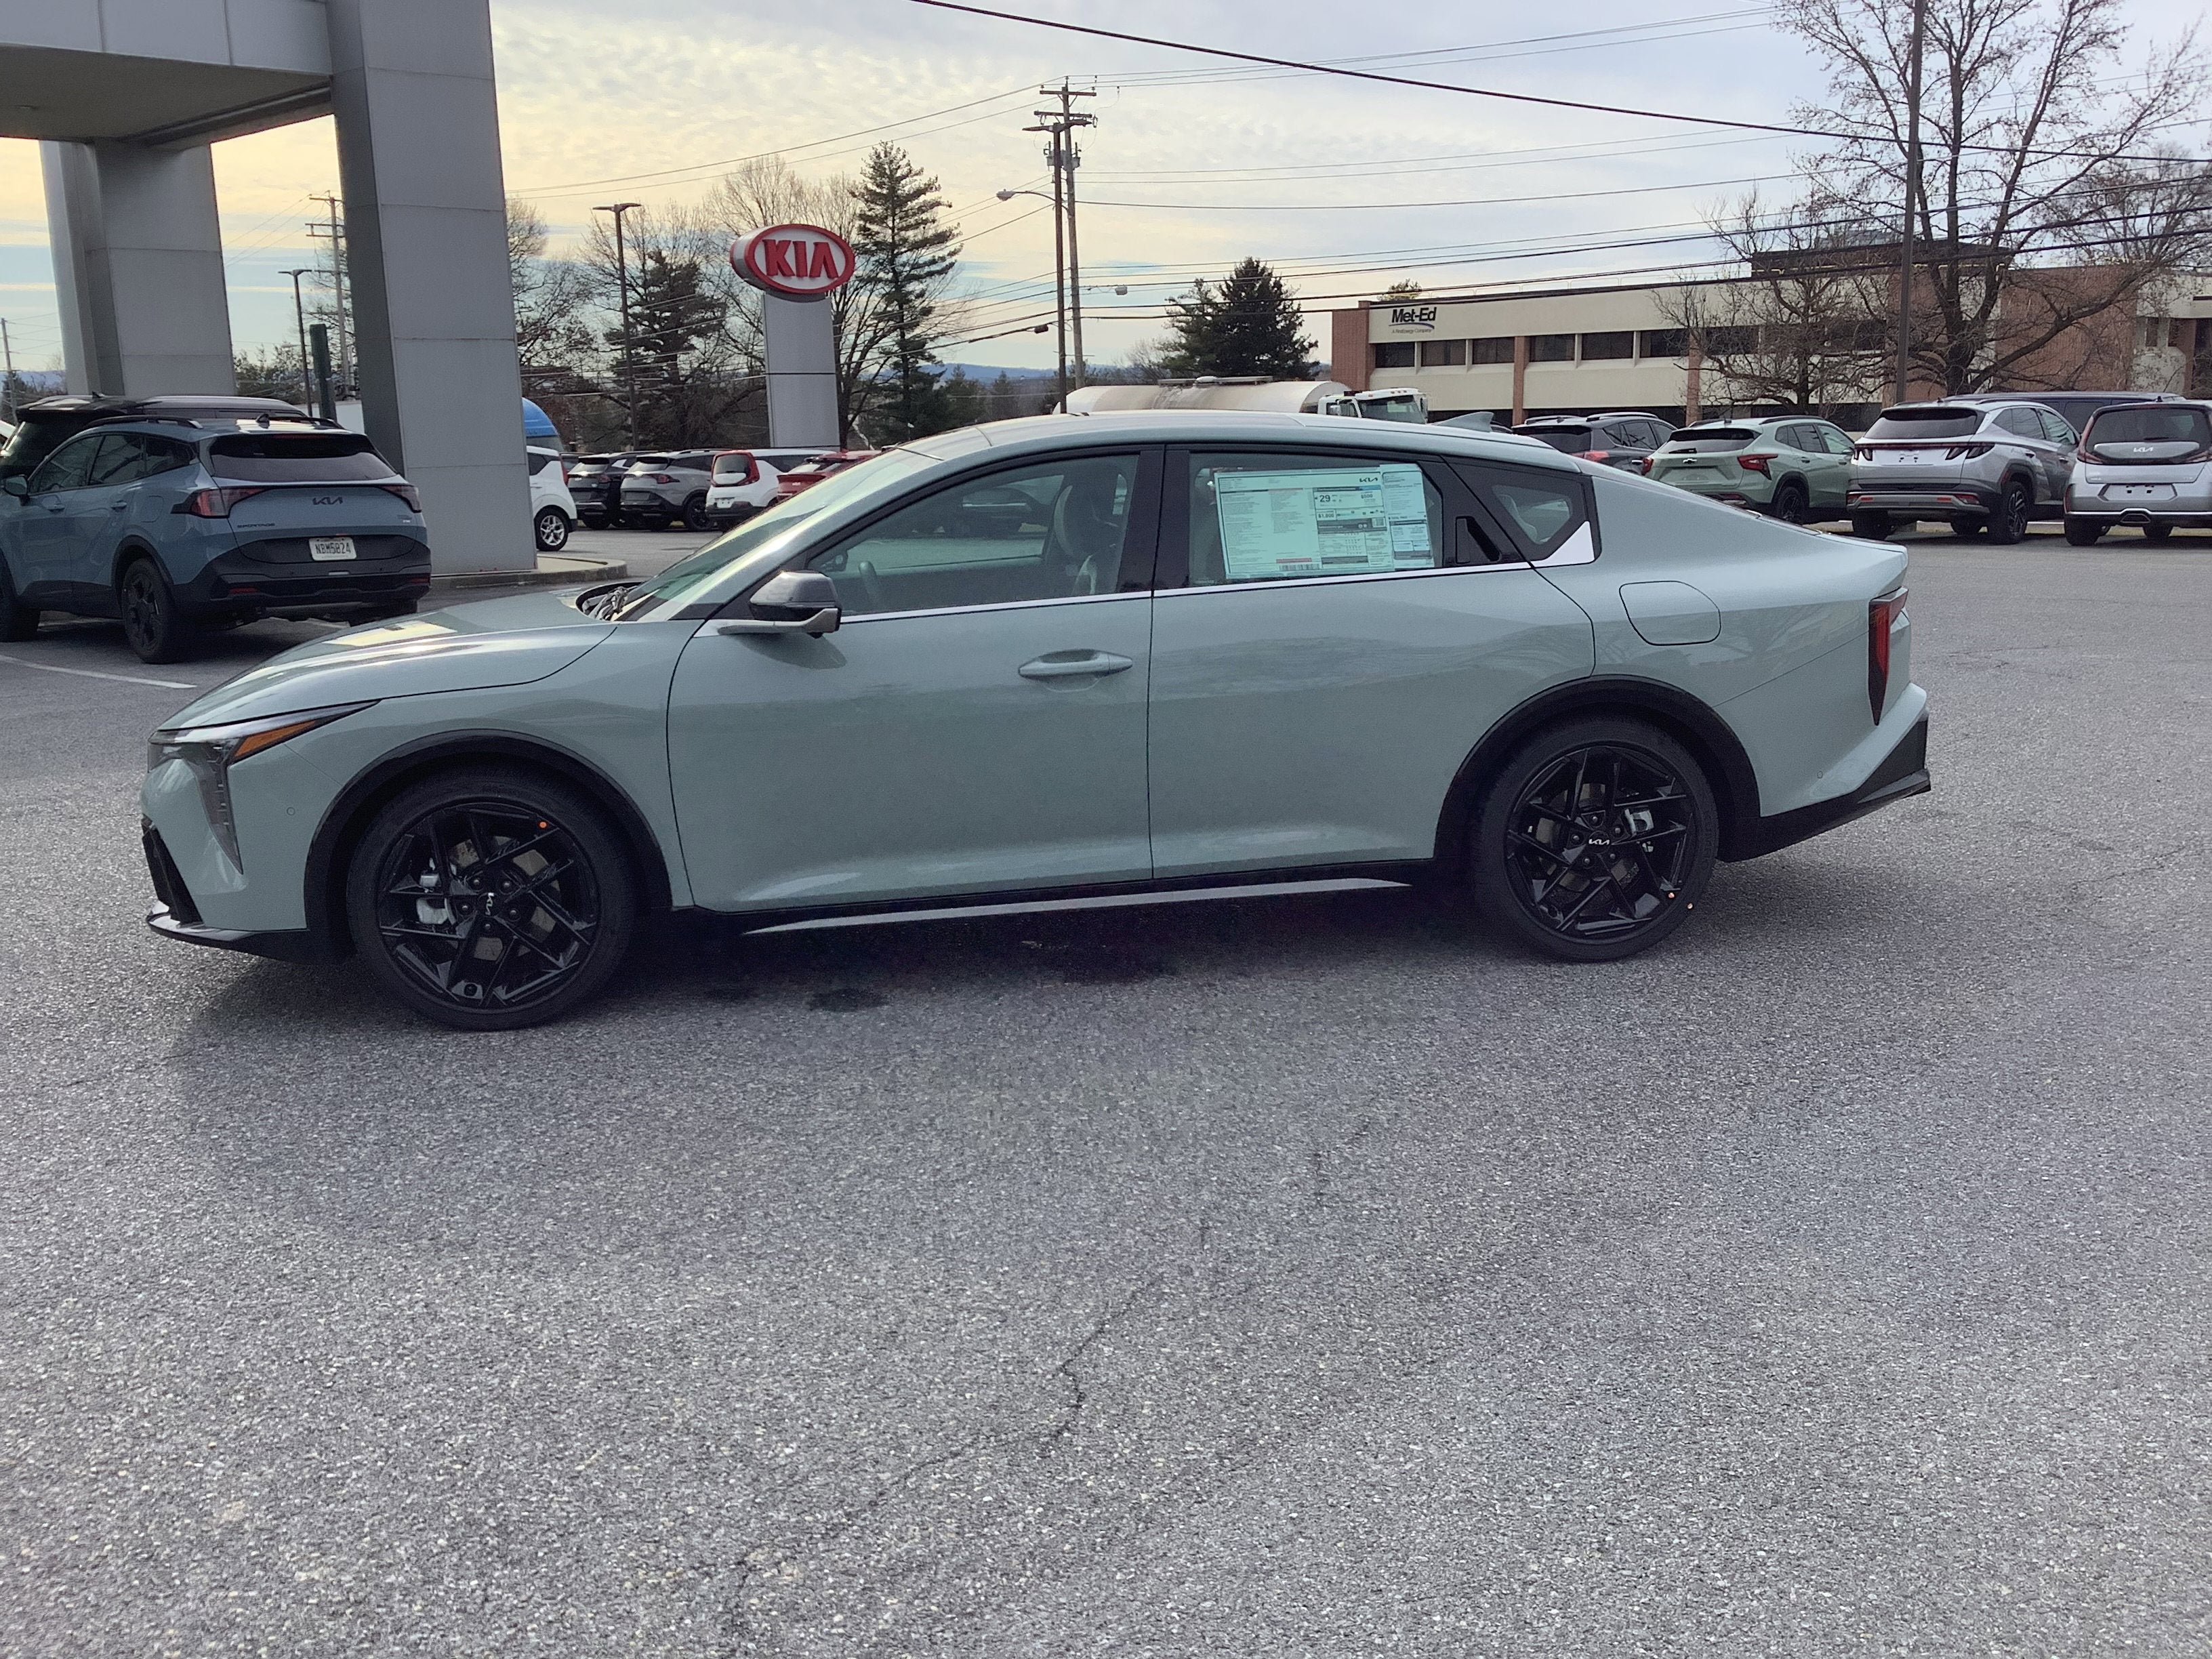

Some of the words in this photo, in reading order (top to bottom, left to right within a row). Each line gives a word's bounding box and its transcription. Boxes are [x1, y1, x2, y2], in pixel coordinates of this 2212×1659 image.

[762, 239, 839, 279] KIA
[1391, 306, 1437, 323] Met-Ed
[312, 497, 343, 506] KIA
